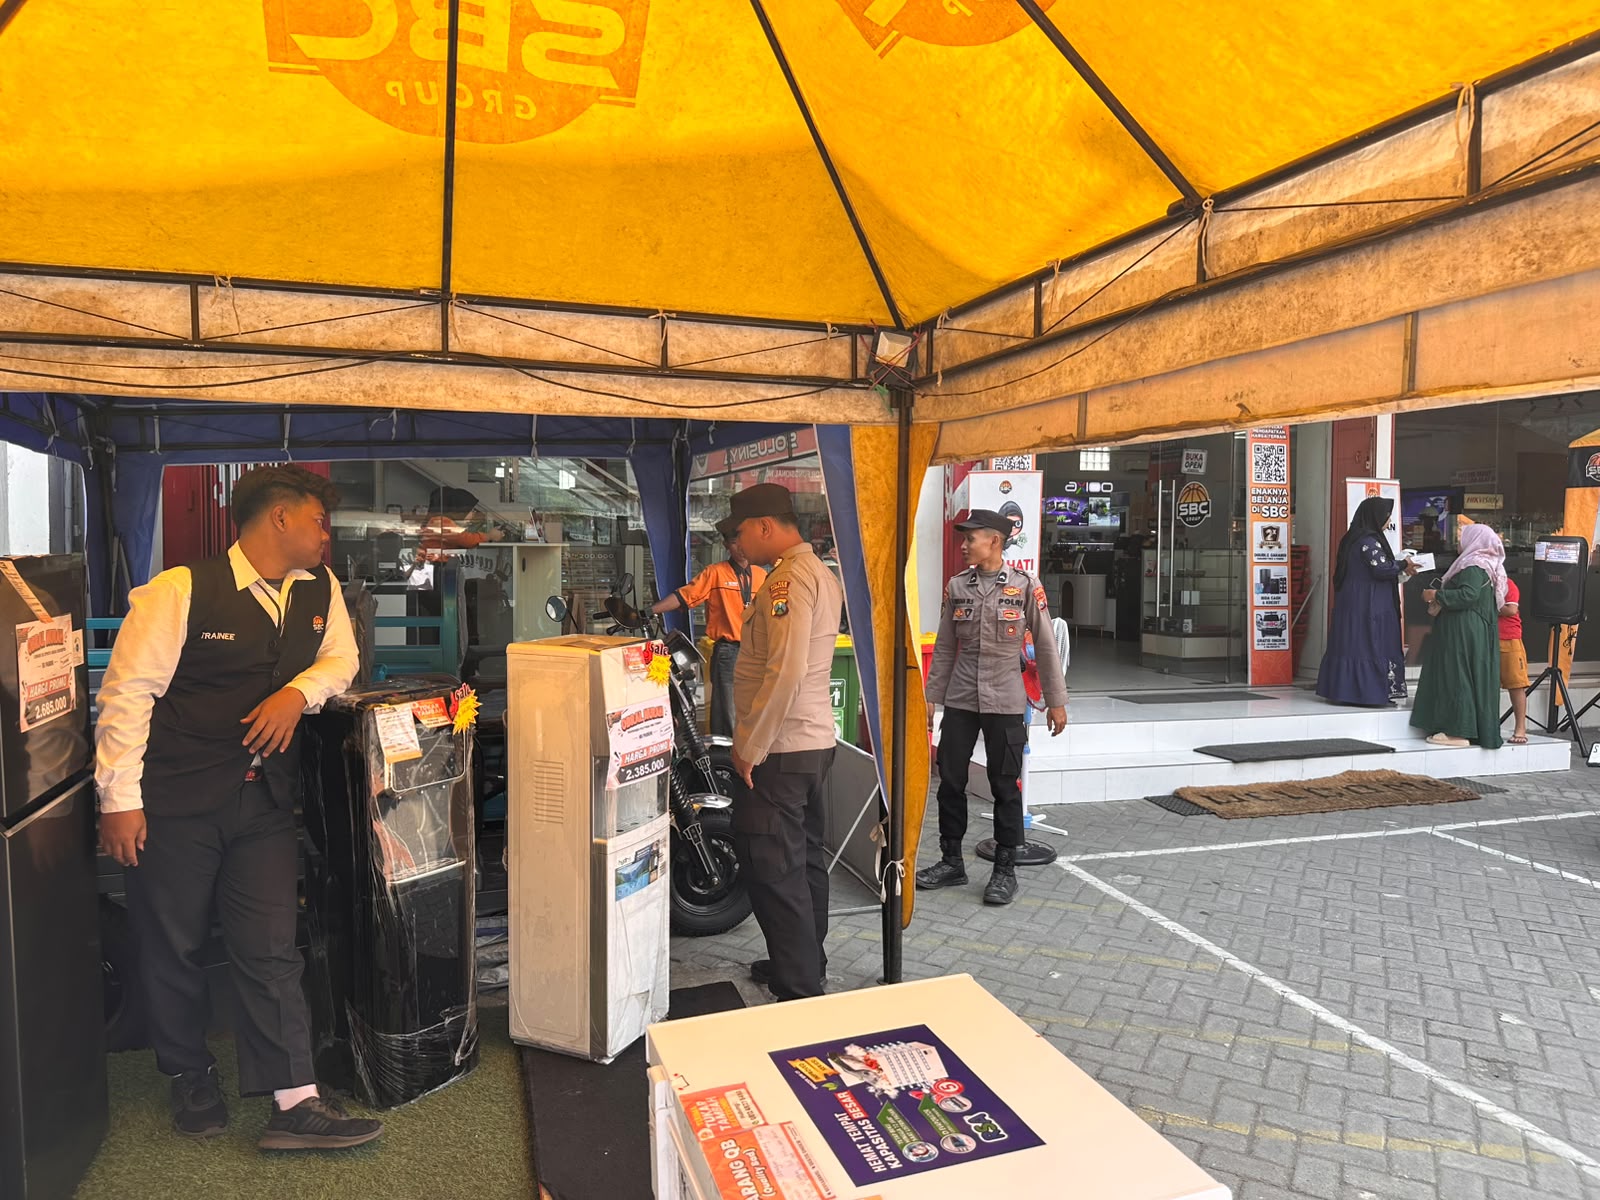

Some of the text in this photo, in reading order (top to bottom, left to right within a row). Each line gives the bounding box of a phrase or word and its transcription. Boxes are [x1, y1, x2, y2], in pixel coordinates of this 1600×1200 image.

[1185, 452, 1203, 461] BUKA
[1184, 461, 1204, 469] OPEN
[1251, 487, 1288, 496] ENAKNYA
[1467, 495, 1499, 503] HIKVISION
[1251, 496, 1288, 504] BELANJA
[1179, 502, 1208, 516] SBC
[1261, 505, 1288, 518] SBC
[998, 599, 1023, 607] POLRI
[29, 682, 49, 699] HARGA
[35, 696, 67, 720] 2.685.000
[624, 741, 668, 764] HARGA PROMO
[625, 758, 665, 780] 2.385.000
[837, 1090, 903, 1169] KAPASITAS BESAR
[964, 1112, 1008, 1142] RSA
[720, 1138, 741, 1160] QB
[834, 1112, 887, 1173] HEMAT TEMPAT
